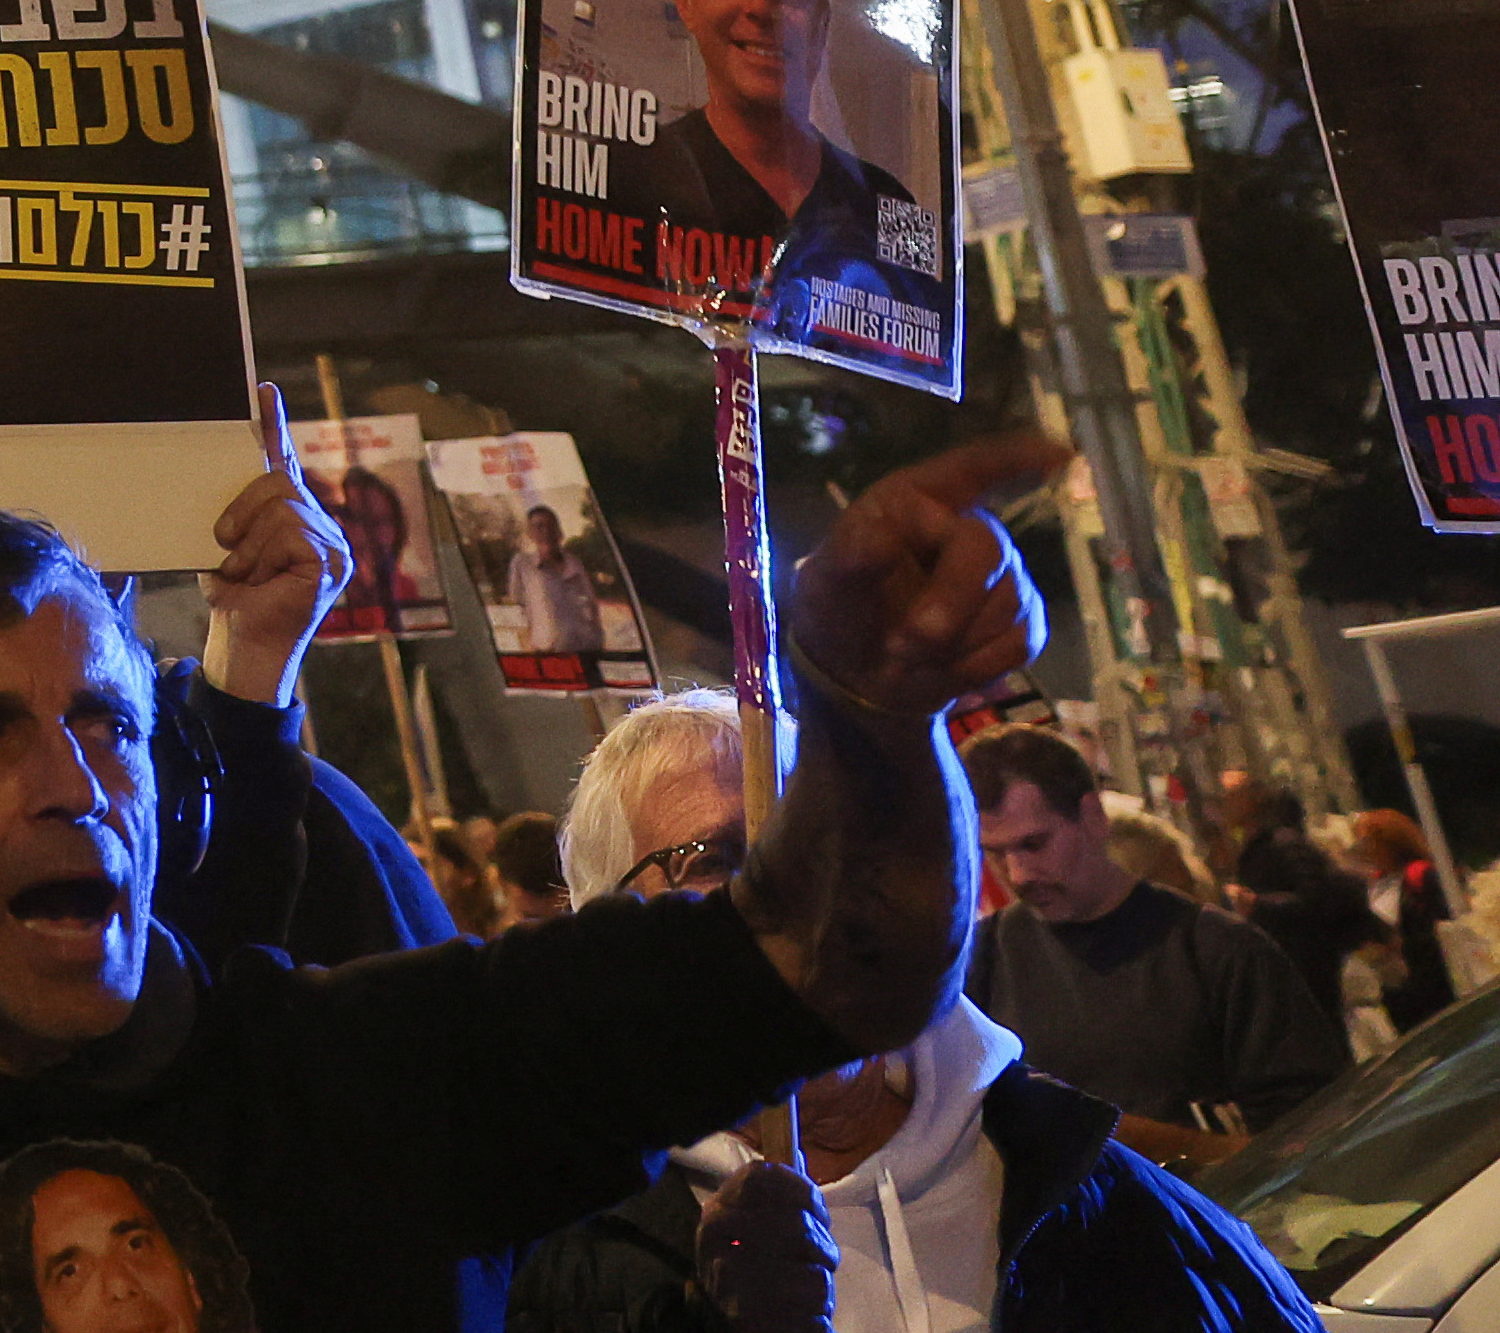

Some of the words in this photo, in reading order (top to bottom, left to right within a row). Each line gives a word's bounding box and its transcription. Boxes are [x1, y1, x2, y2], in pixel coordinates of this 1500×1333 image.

[538, 69, 657, 147] BRING
[537, 131, 609, 200] HIM
[536, 195, 645, 275] HOME
[656, 217, 776, 295] NOW!
[811, 276, 867, 312] HOSTAGES
[867, 288, 890, 315] AND
[891, 295, 941, 332] MISSING
[1383, 252, 1500, 325] BRIN
[810, 297, 880, 342] FAMILIES
[883, 317, 941, 359] FORUM
[1404, 330, 1500, 401] HIM
[1426, 413, 1500, 484] HO
